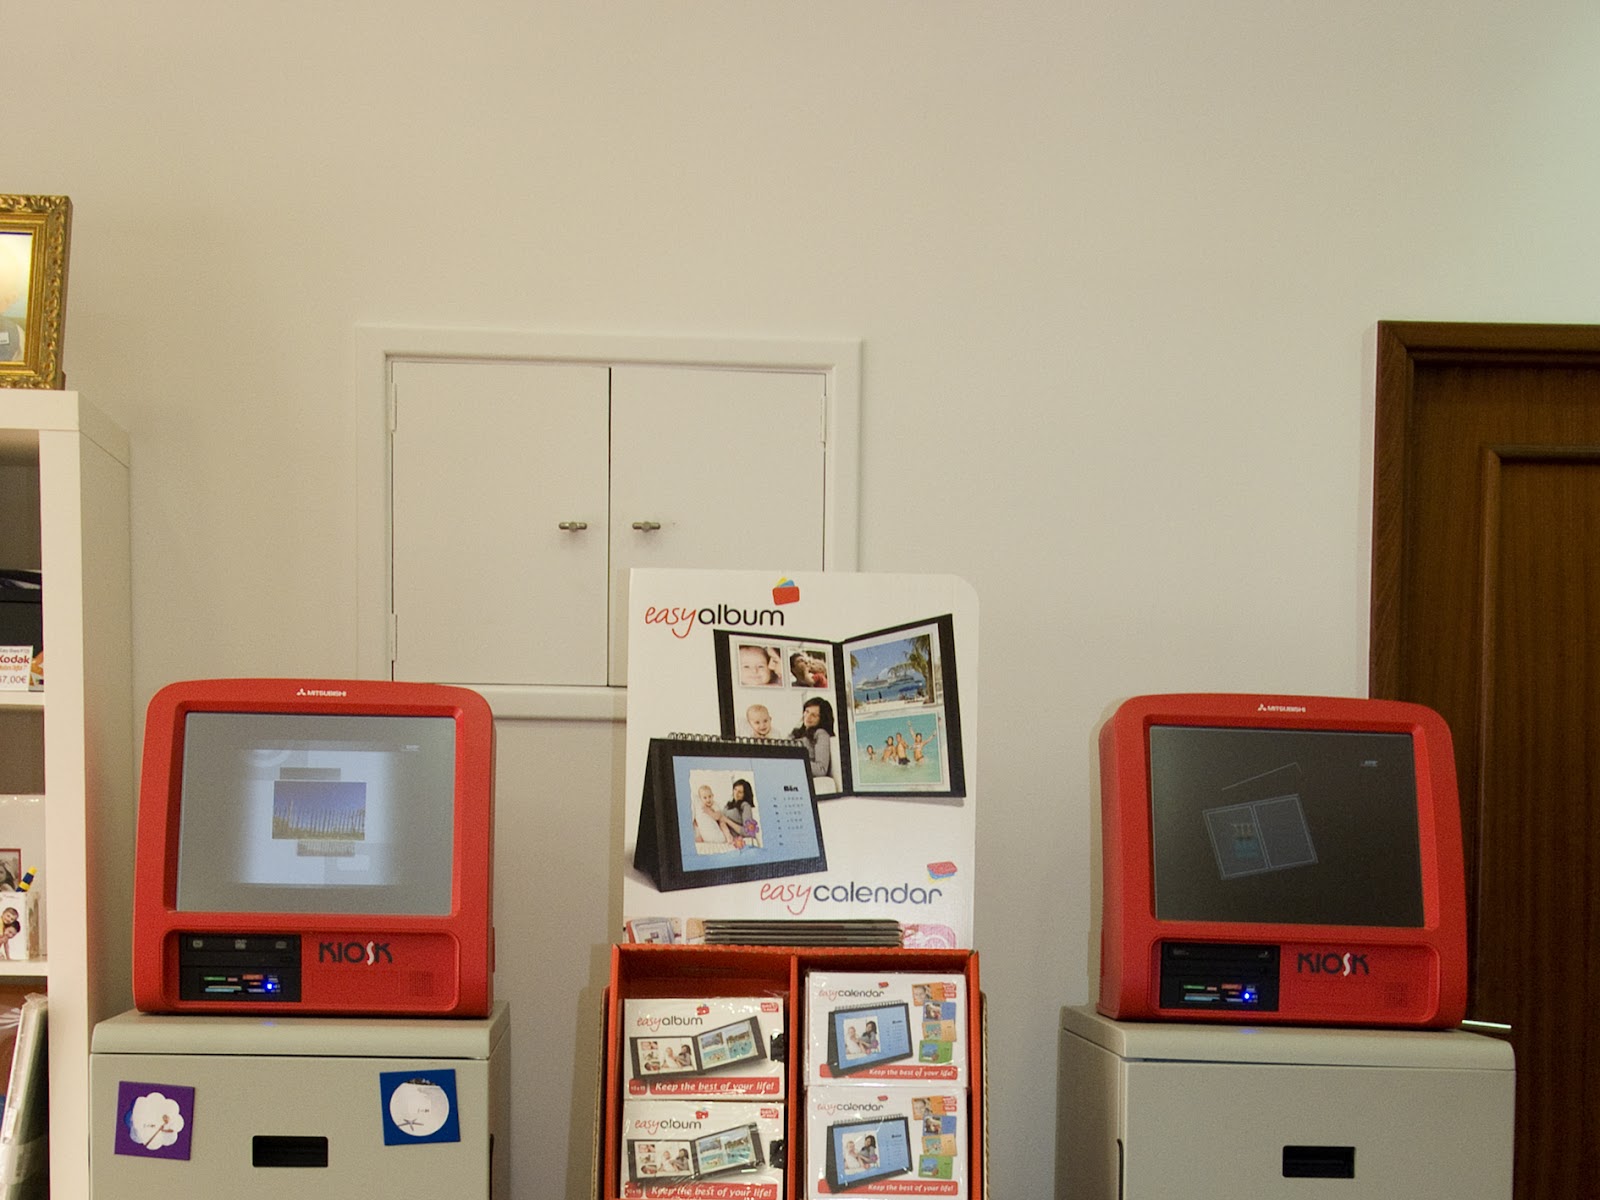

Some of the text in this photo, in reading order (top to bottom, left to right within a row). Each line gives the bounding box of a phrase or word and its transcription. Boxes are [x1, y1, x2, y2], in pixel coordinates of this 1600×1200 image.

[307, 689, 347, 697] MITSUBISHI
[319, 941, 393, 966] KIOSK
[1297, 952, 1370, 977] KIOSK
[868, 1068, 886, 1076] Keep
[887, 1068, 898, 1076] the
[899, 1068, 913, 1076] best
[655, 1081, 679, 1092] Keep
[680, 1081, 695, 1091] the
[698, 1081, 717, 1091] best
[720, 1081, 731, 1092] of
[677, 1185, 692, 1196] the
[695, 1185, 714, 1196] best
[716, 1186, 728, 1197] of
[730, 1187, 751, 1197] your
[753, 1186, 772, 1197] life!
[868, 1184, 885, 1192] Keep
